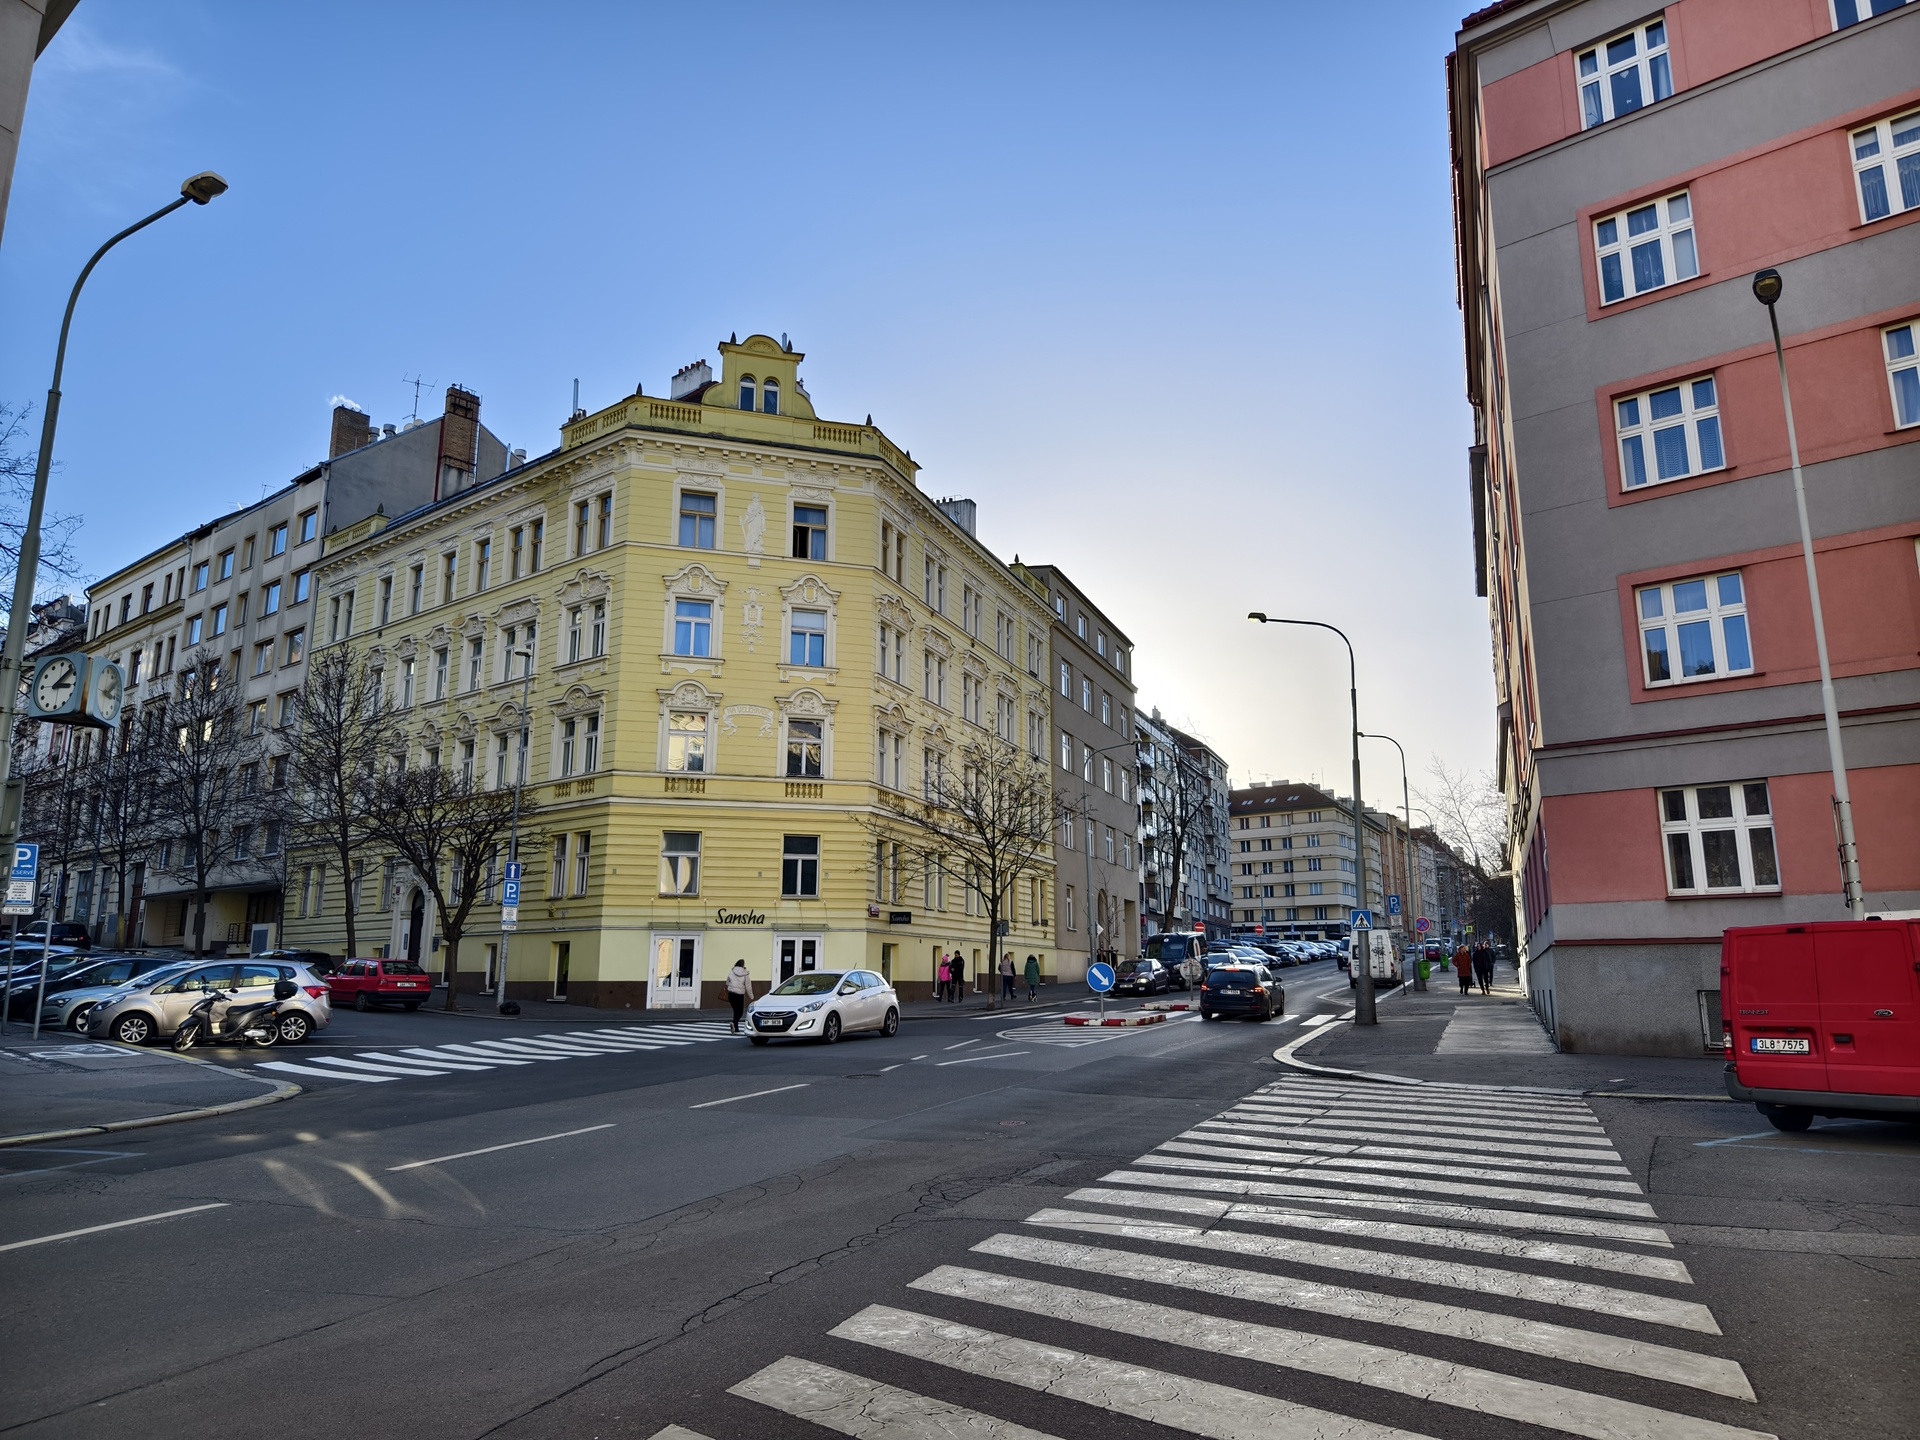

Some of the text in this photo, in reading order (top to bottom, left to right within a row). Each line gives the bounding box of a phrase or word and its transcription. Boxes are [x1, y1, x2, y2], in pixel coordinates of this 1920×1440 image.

[14, 848, 31, 867] P
[506, 883, 517, 897] P
[1390, 897, 1398, 908] P
[715, 908, 765, 924] Sansha
[1759, 1039, 1805, 1050] 3L8 7575
